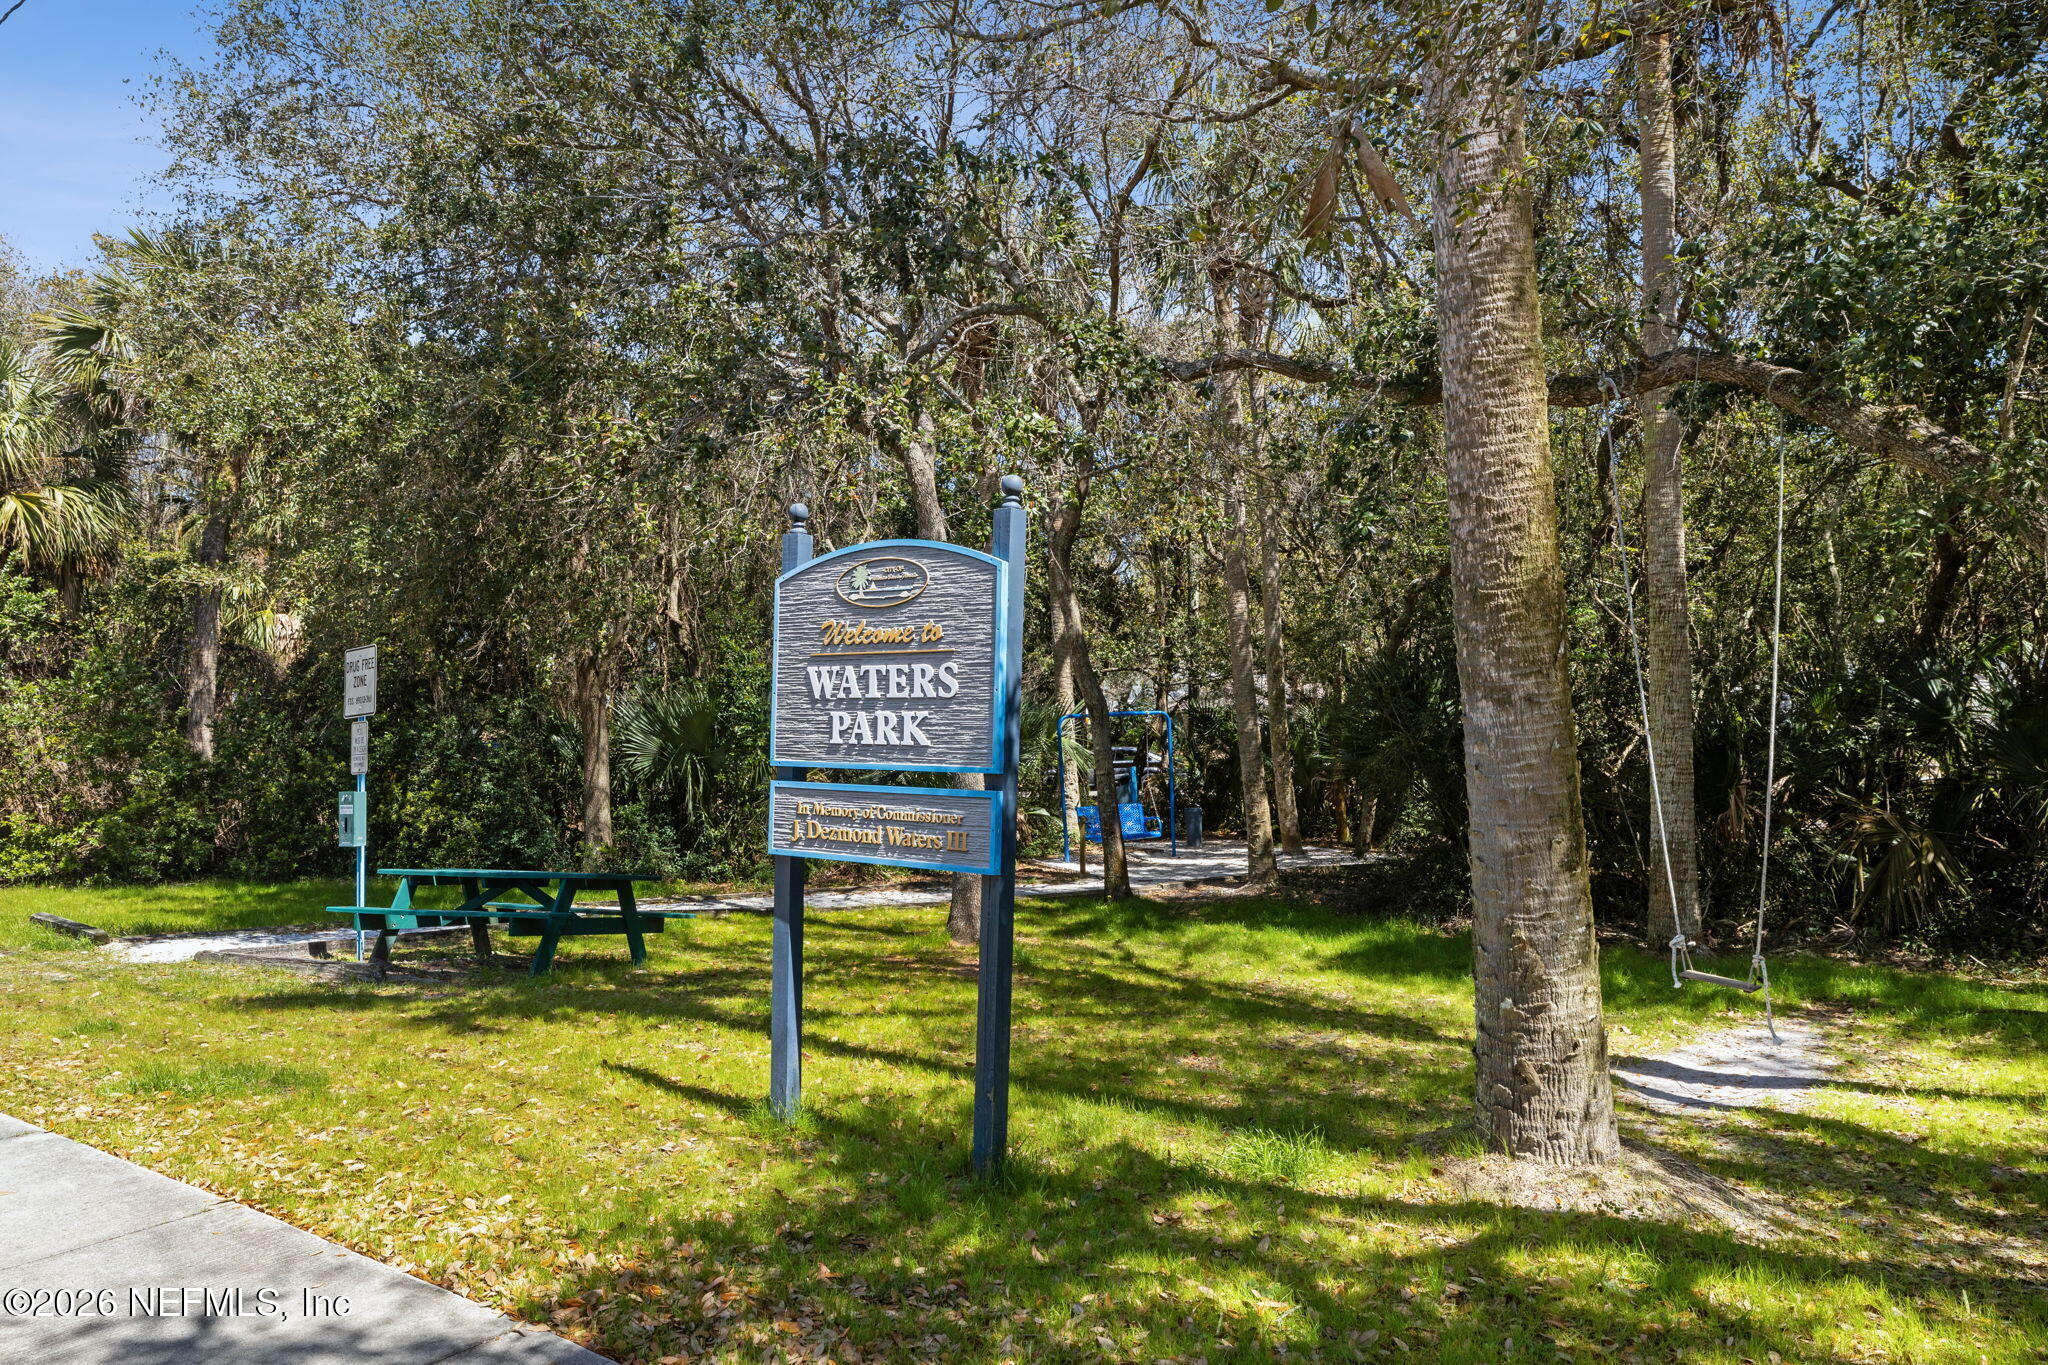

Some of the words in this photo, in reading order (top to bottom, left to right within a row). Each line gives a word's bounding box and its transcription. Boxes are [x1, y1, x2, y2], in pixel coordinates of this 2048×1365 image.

[821, 618, 913, 646] Welcome
[920, 618, 944, 644] to
[362, 657, 375, 671] FREE
[353, 674, 368, 688] ZONE
[806, 661, 959, 700] WATERS
[829, 710, 932, 747] PARK
[797, 801, 809, 815] In
[813, 801, 860, 821] Memory
[862, 805, 877, 819] of
[877, 806, 964, 825] Commissioner
[806, 820, 882, 845] Dezmond
[886, 825, 943, 850] Waters
[947, 830, 968, 851] III
